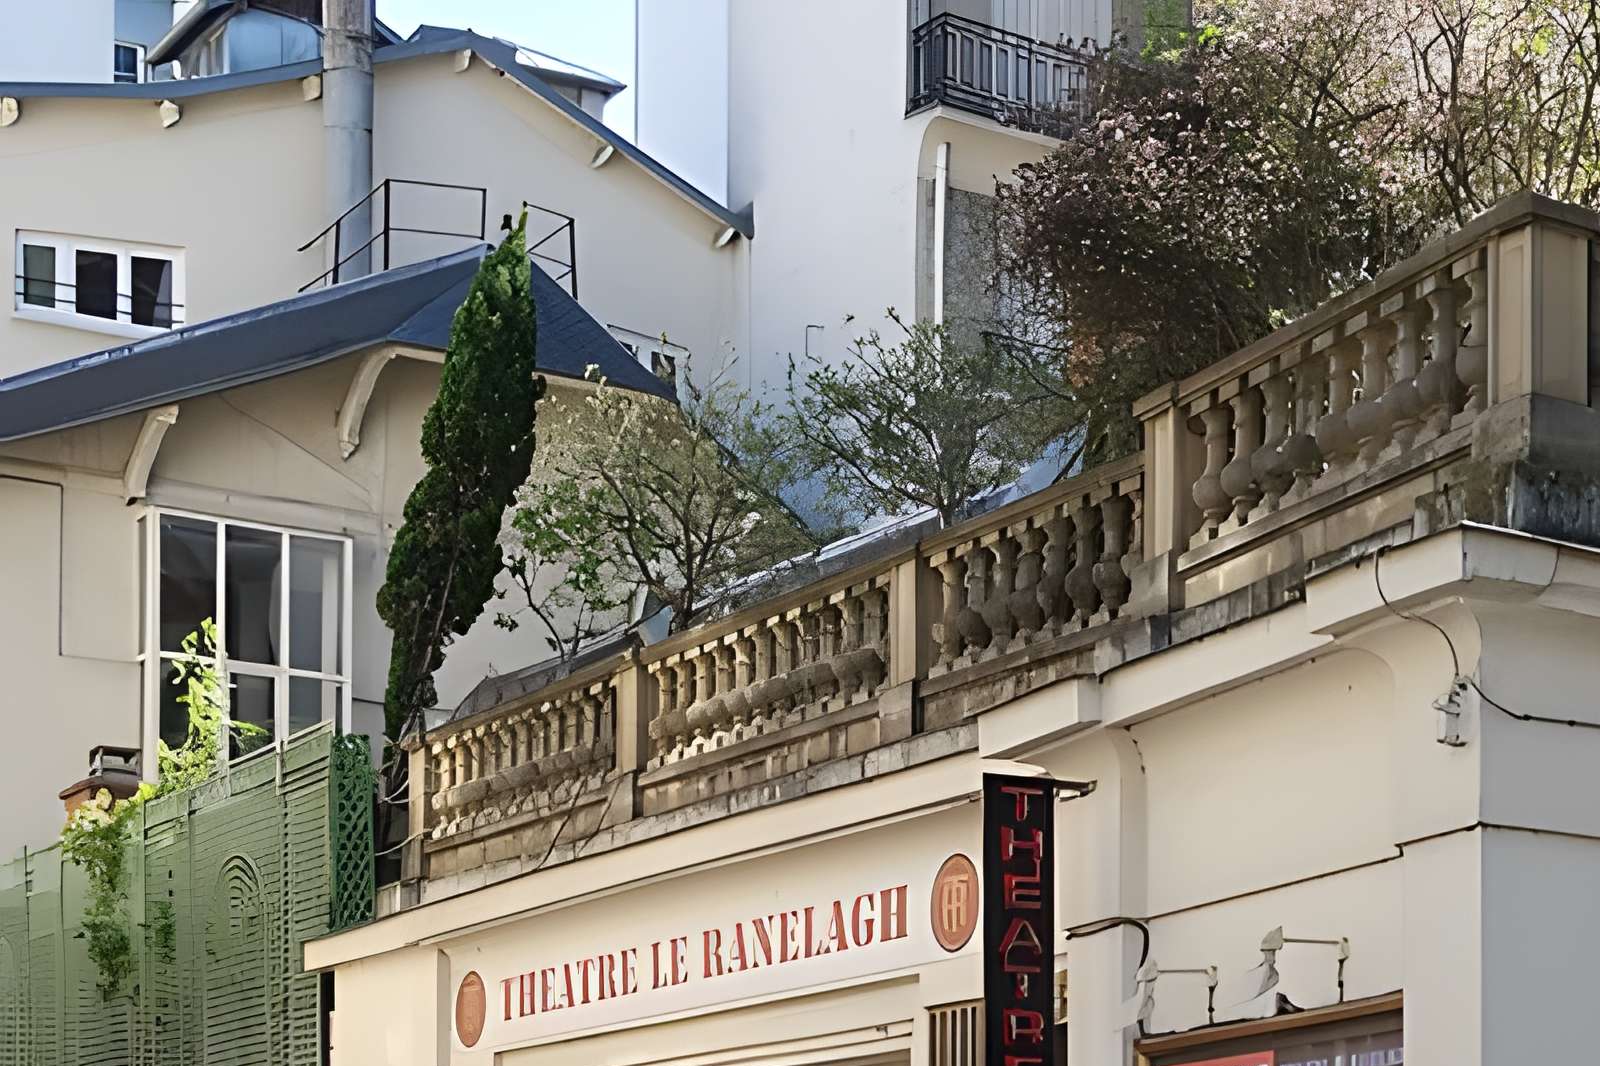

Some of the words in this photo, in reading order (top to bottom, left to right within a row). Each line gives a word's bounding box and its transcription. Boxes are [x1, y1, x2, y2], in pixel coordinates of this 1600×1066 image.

[500, 948, 637, 1021] THEATRE
[651, 936, 688, 990] LE
[702, 884, 910, 979] RANELAGH
